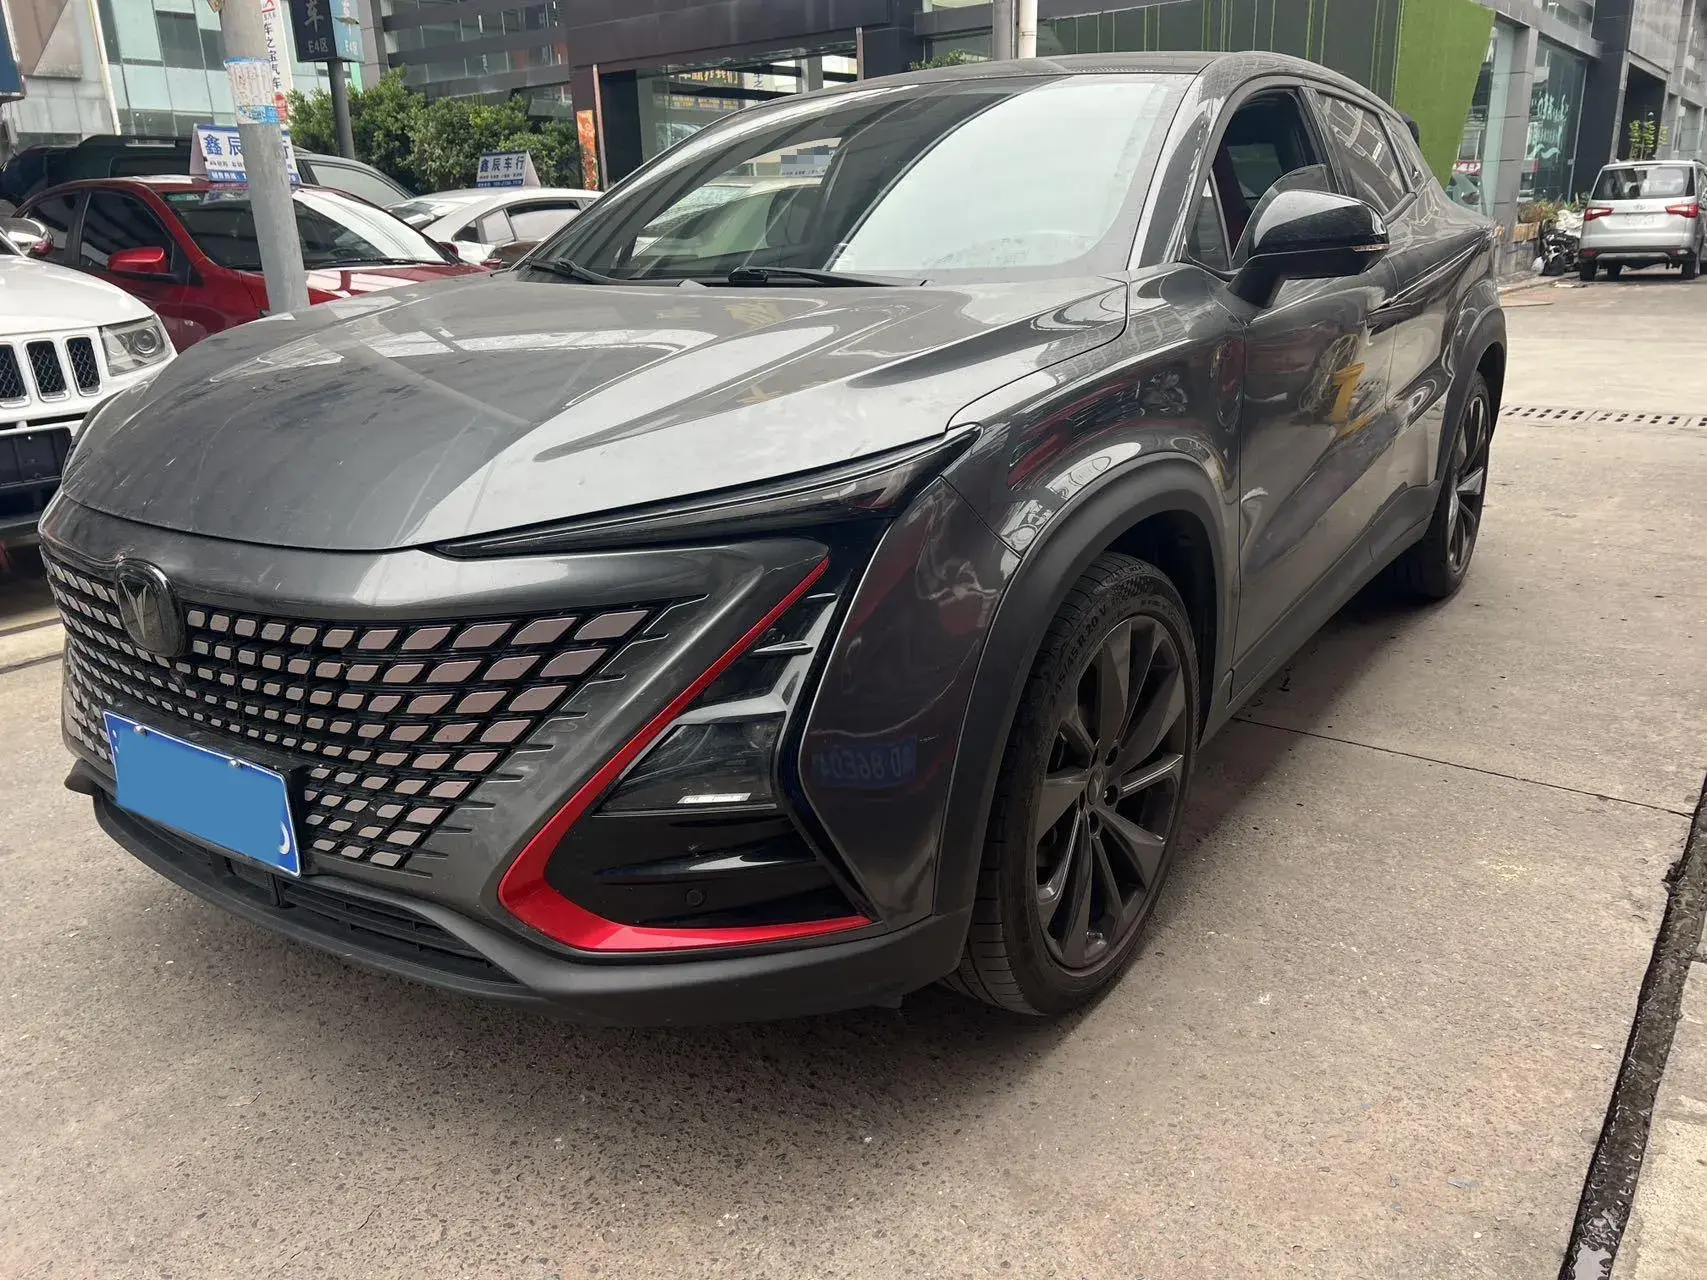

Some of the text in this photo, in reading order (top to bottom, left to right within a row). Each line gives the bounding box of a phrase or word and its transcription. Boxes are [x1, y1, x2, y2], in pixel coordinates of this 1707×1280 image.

[480, 156, 524, 173] 鑫辰车行
[1085, 616, 1099, 634] 20
